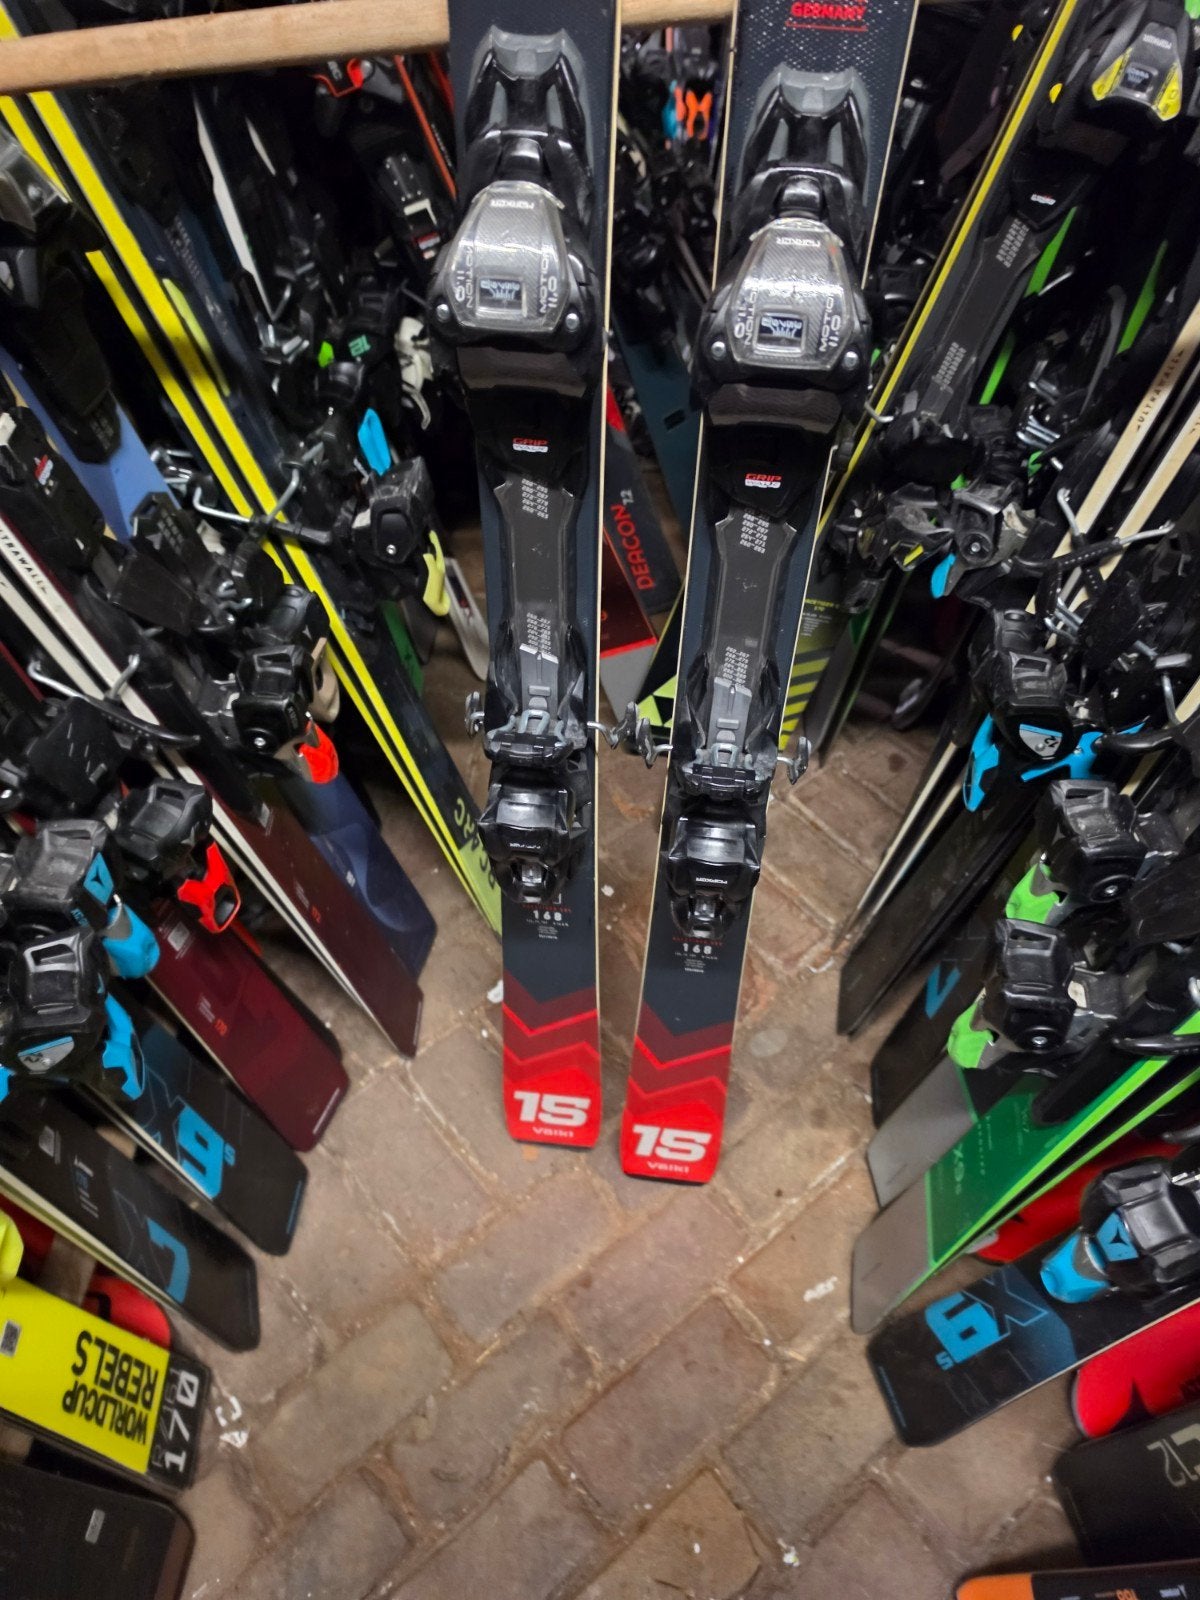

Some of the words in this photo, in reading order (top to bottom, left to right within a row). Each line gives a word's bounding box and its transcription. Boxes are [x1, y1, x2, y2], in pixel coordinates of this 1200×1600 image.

[791, 2, 867, 20] GERMANY
[744, 473, 782, 482] GRIP
[610, 503, 657, 592] DEACON
[532, 909, 563, 922] 168
[682, 942, 713, 955] 168
[513, 1090, 591, 1128] 15
[632, 1123, 713, 1163] 15
[71, 1330, 159, 1411] REBELS
[62, 1380, 148, 1445] WORLDCUP
[164, 1370, 199, 1473] 170
